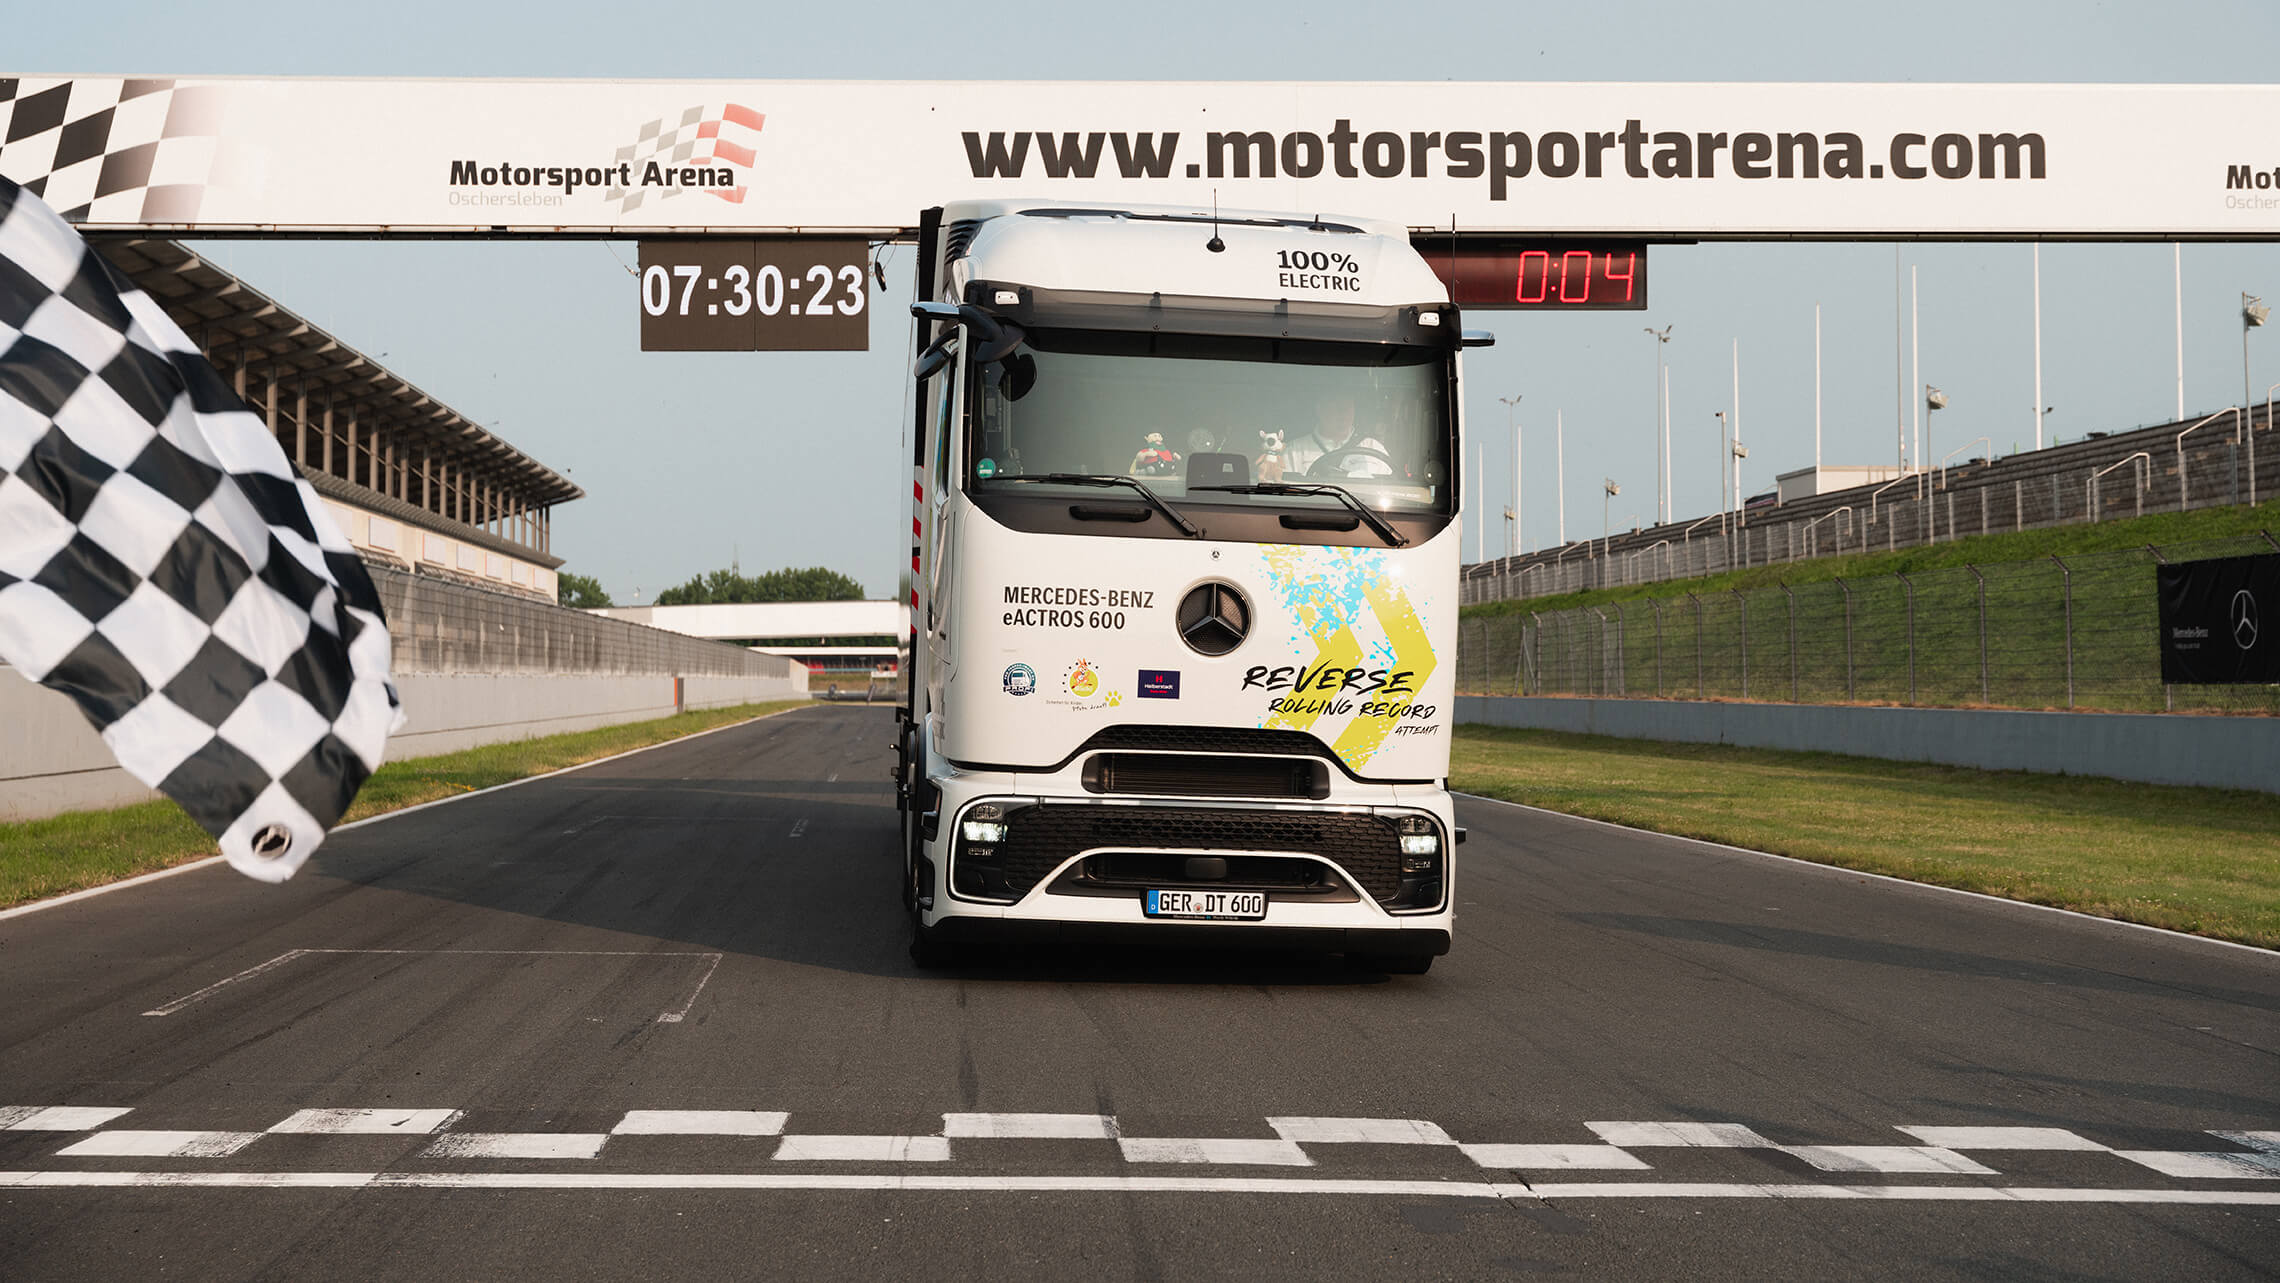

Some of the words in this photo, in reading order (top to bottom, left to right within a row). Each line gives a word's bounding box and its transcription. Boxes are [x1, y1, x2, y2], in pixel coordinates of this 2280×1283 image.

[961, 118, 2046, 201] www.motorsportarena.com
[449, 160, 631, 195] Motorsport
[641, 161, 734, 187] Arena
[448, 190, 563, 207] Oschersleben
[1276, 249, 1359, 274] 100%
[1279, 272, 1361, 292] ELECTRIC
[1515, 250, 1637, 304] 0:04
[641, 264, 866, 317] 07:30:23
[1004, 586, 1154, 609] MERCEDES-BENZ
[1002, 608, 1084, 628] eACTROS
[1089, 611, 1126, 630] 600
[1241, 658, 1415, 696] REVERSE
[1268, 697, 1354, 716] ROLLING
[1358, 701, 1437, 720] RECORD
[1394, 724, 1440, 737] ATTEMPT
[1159, 893, 1192, 912] GER
[1205, 894, 1226, 913] DT
[1230, 895, 1262, 914] 600
